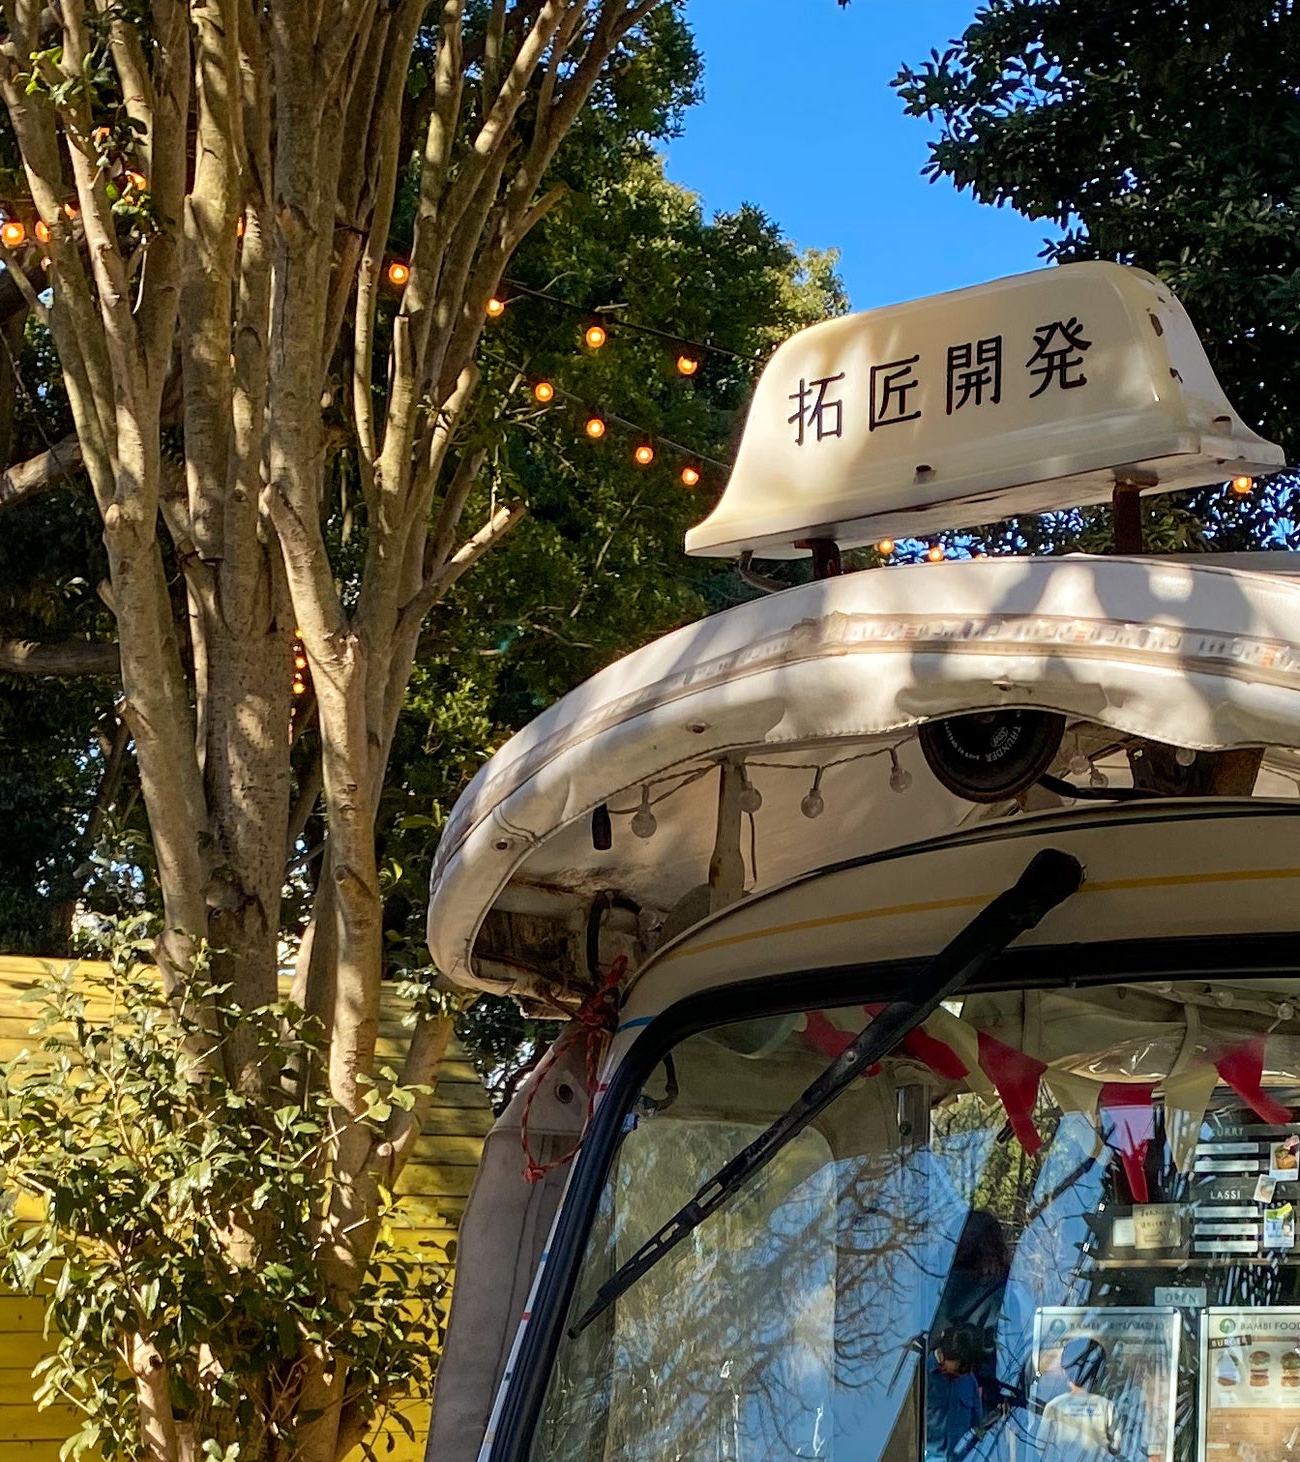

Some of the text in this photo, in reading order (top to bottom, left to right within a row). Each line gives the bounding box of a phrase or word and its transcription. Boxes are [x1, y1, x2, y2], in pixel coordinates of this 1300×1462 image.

[787, 315, 1093, 446] 拓匠開発
[985, 725, 1022, 762] THUNDER
[1210, 1190, 1241, 1200] LASSI
